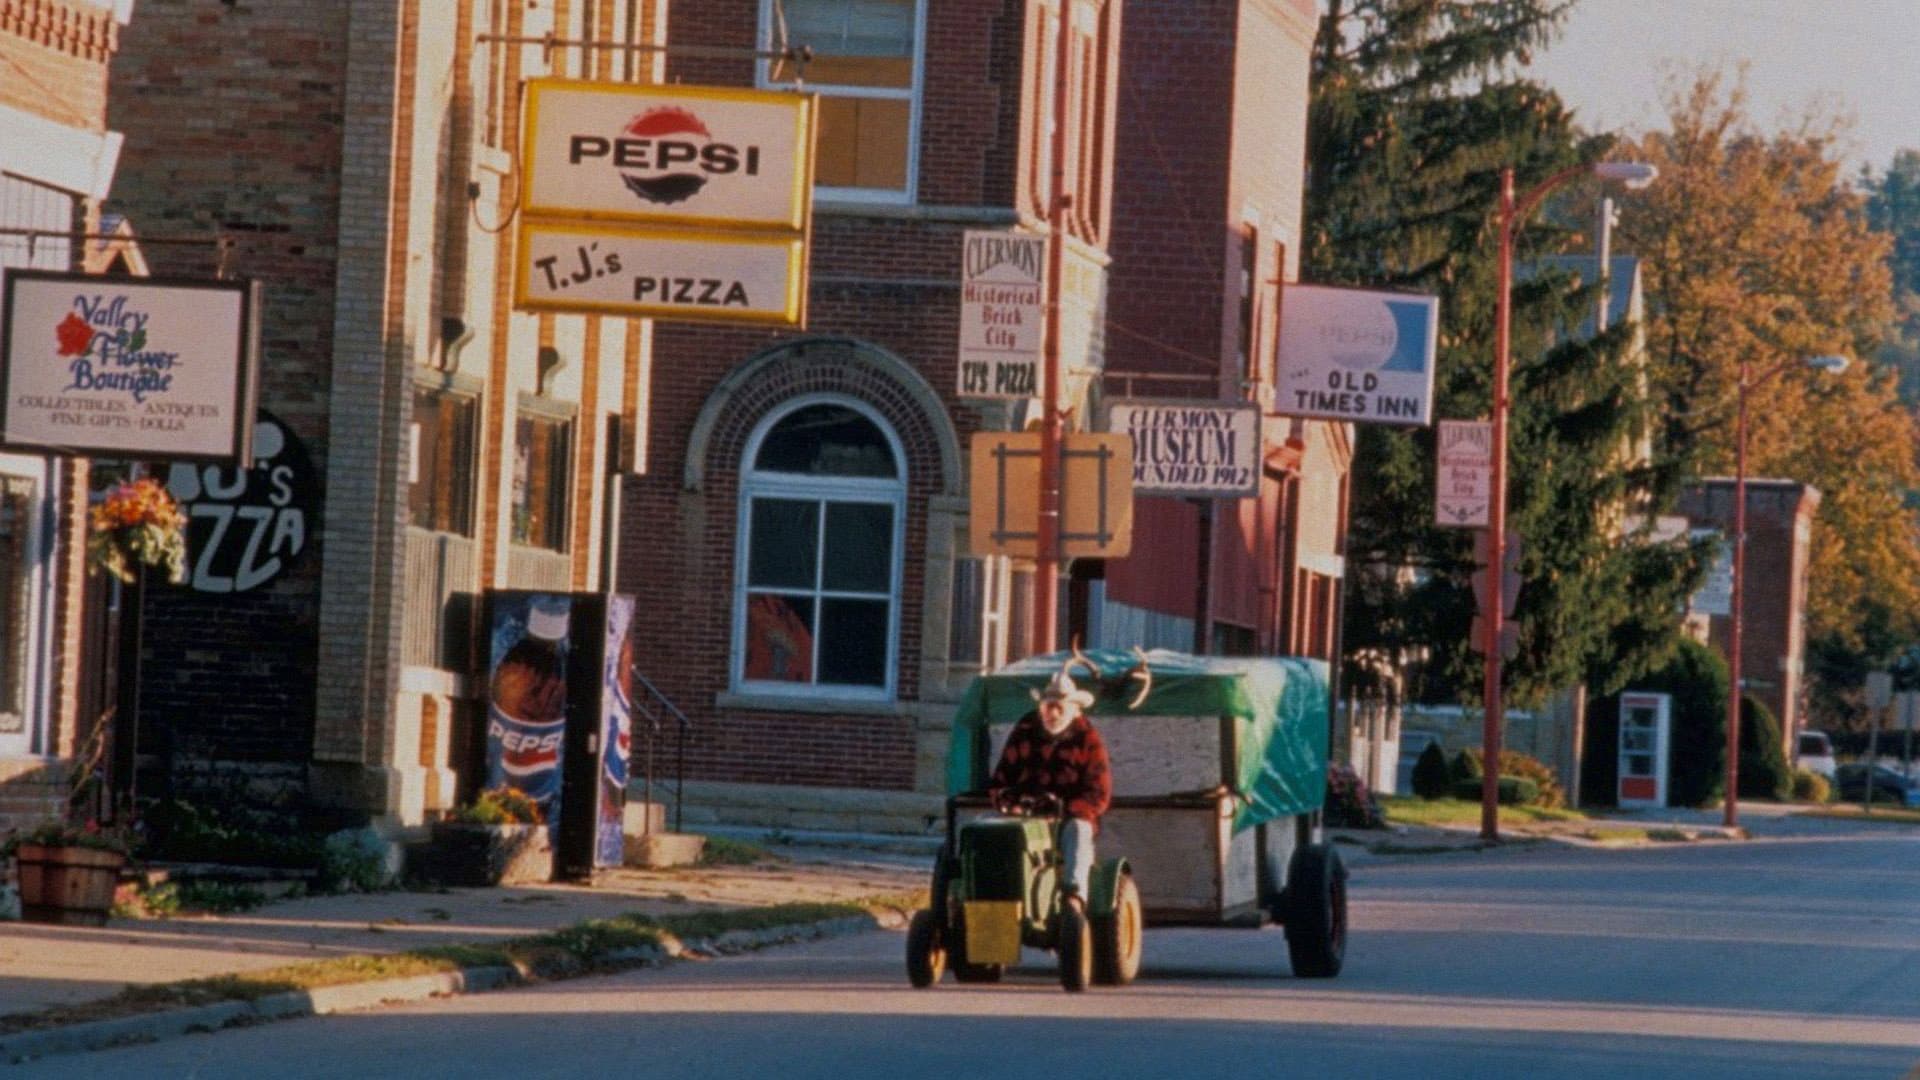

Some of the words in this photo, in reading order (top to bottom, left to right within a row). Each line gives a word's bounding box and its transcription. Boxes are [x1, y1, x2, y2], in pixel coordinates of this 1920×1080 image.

[569, 135, 760, 176] PEPSI
[967, 238, 1044, 283] CLERMONT
[634, 277, 749, 307] PIZZA
[965, 284, 1041, 304] Historical
[74, 294, 149, 332] Valley
[982, 305, 1022, 325] Brick
[94, 332, 184, 368] Flower
[986, 326, 1016, 348] City
[63, 358, 174, 403] Boutique
[996, 361, 1037, 397] PIZZA
[1328, 371, 1378, 392] OLD
[17, 394, 127, 412] COLLECTIBLES
[145, 402, 219, 418] ANTIQUES
[1295, 390, 1367, 413] TIMES
[1377, 396, 1419, 417] INN
[51, 412, 84, 427] FINE
[89, 414, 131, 428] GIFTS
[140, 417, 185, 431] DOLLS
[1130, 410, 1234, 429] CLERMONT
[1128, 427, 1236, 466] MUSEUM
[1132, 465, 1206, 483] OUNDED
[1213, 467, 1249, 486] 1912
[181, 504, 305, 592] ZZA
